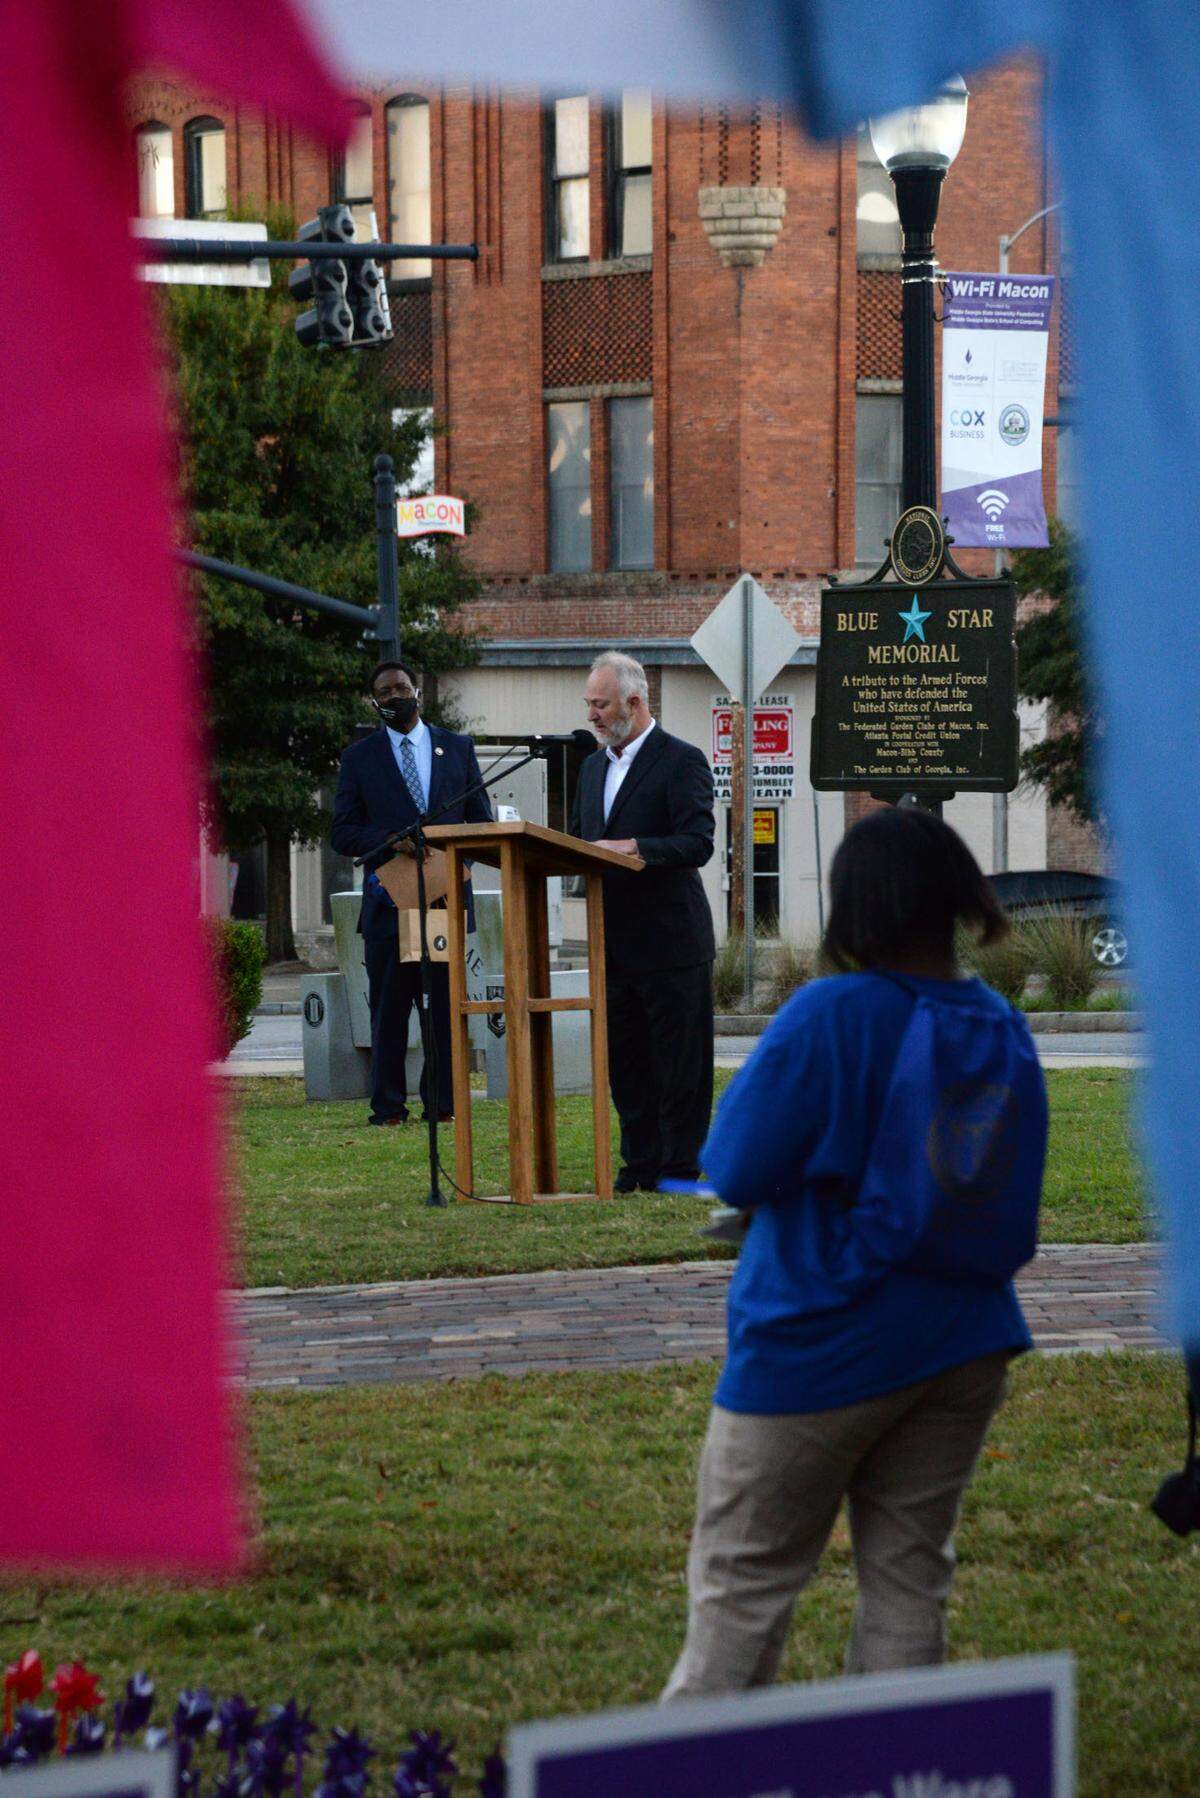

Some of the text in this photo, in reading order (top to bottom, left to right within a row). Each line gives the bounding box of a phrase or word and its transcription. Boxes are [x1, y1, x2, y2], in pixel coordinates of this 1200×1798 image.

[952, 280, 1049, 299] Wi-Fi Macon
[950, 410, 985, 426] COX
[950, 430, 985, 439] BUSINESS
[985, 524, 1004, 533] FREE
[836, 609, 994, 632] BLUE STAR
[867, 644, 961, 664] MEMORIAL
[842, 672, 988, 687] A tribute to the Armed Forces
[858, 686, 968, 700] who have defended the
[760, 696, 789, 706] LEASE
[853, 700, 973, 713] United States of America
[838, 722, 850, 731] The
[853, 721, 888, 731] Federated
[890, 721, 914, 731] Garden
[938, 721, 947, 730] of
[864, 731, 889, 740] Atlanta
[914, 731, 937, 740] Credit
[940, 731, 961, 740] Union
[920, 747, 945, 757] County
[853, 765, 867, 774] The
[869, 765, 893, 774] Garden
[895, 765, 912, 774] Club
[913, 765, 922, 774] of
